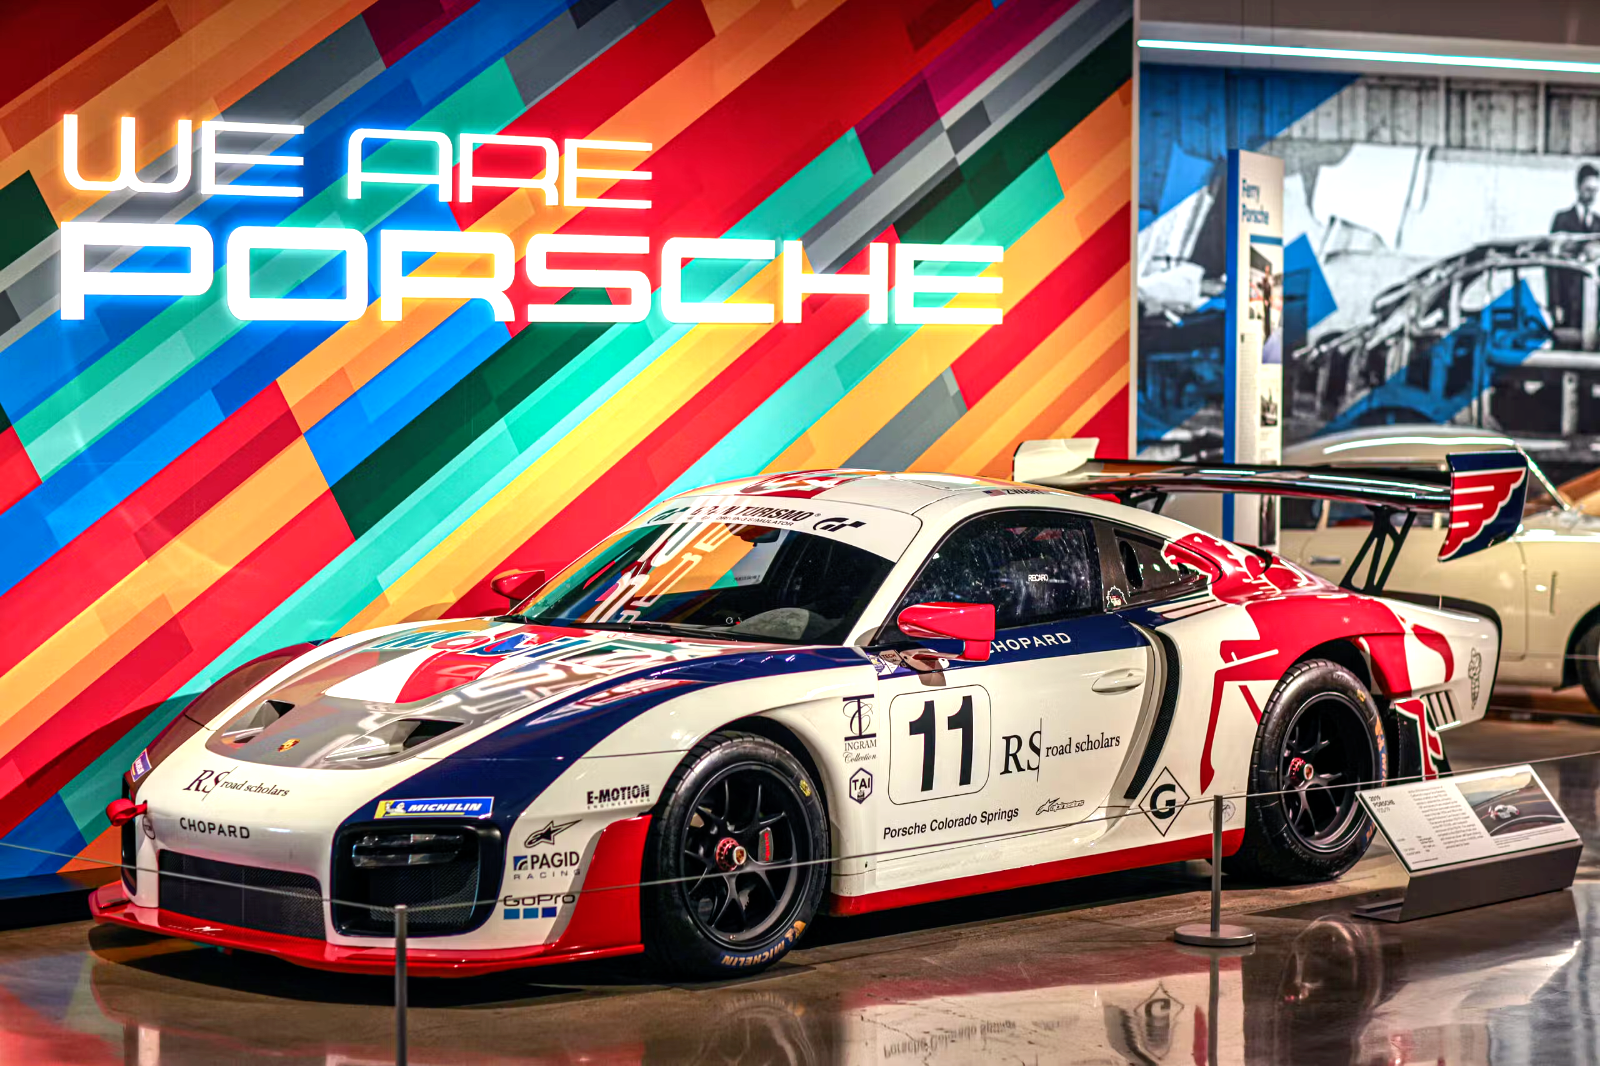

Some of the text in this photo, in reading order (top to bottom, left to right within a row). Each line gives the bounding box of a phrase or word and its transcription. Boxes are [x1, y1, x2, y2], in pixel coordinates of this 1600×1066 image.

[62, 113, 653, 209] WE ARE
[1242, 178, 1260, 203] Ferry
[1242, 203, 1270, 226] Porsche
[59, 221, 1005, 325] PORSCHE
[1027, 573, 1049, 582] RECARO
[989, 632, 1072, 654] HOPARD
[844, 739, 877, 752] INGRAM
[908, 694, 975, 793] 11
[1045, 736, 1072, 758] road
[1074, 732, 1121, 753] scholars
[843, 750, 877, 764] Collection
[220, 779, 247, 790] road
[245, 782, 290, 797] scholars
[587, 784, 650, 805] E-MOTION
[852, 777, 871, 790] TAI
[407, 802, 483, 812] MICHELIN
[1149, 783, 1177, 820] G
[179, 816, 251, 840] CHOPARD
[883, 807, 1020, 840] Porsche Colorado Springs
[530, 851, 580, 870] PAGID
[513, 868, 581, 880] RACING
[721, 940, 785, 967] MICHELIN
